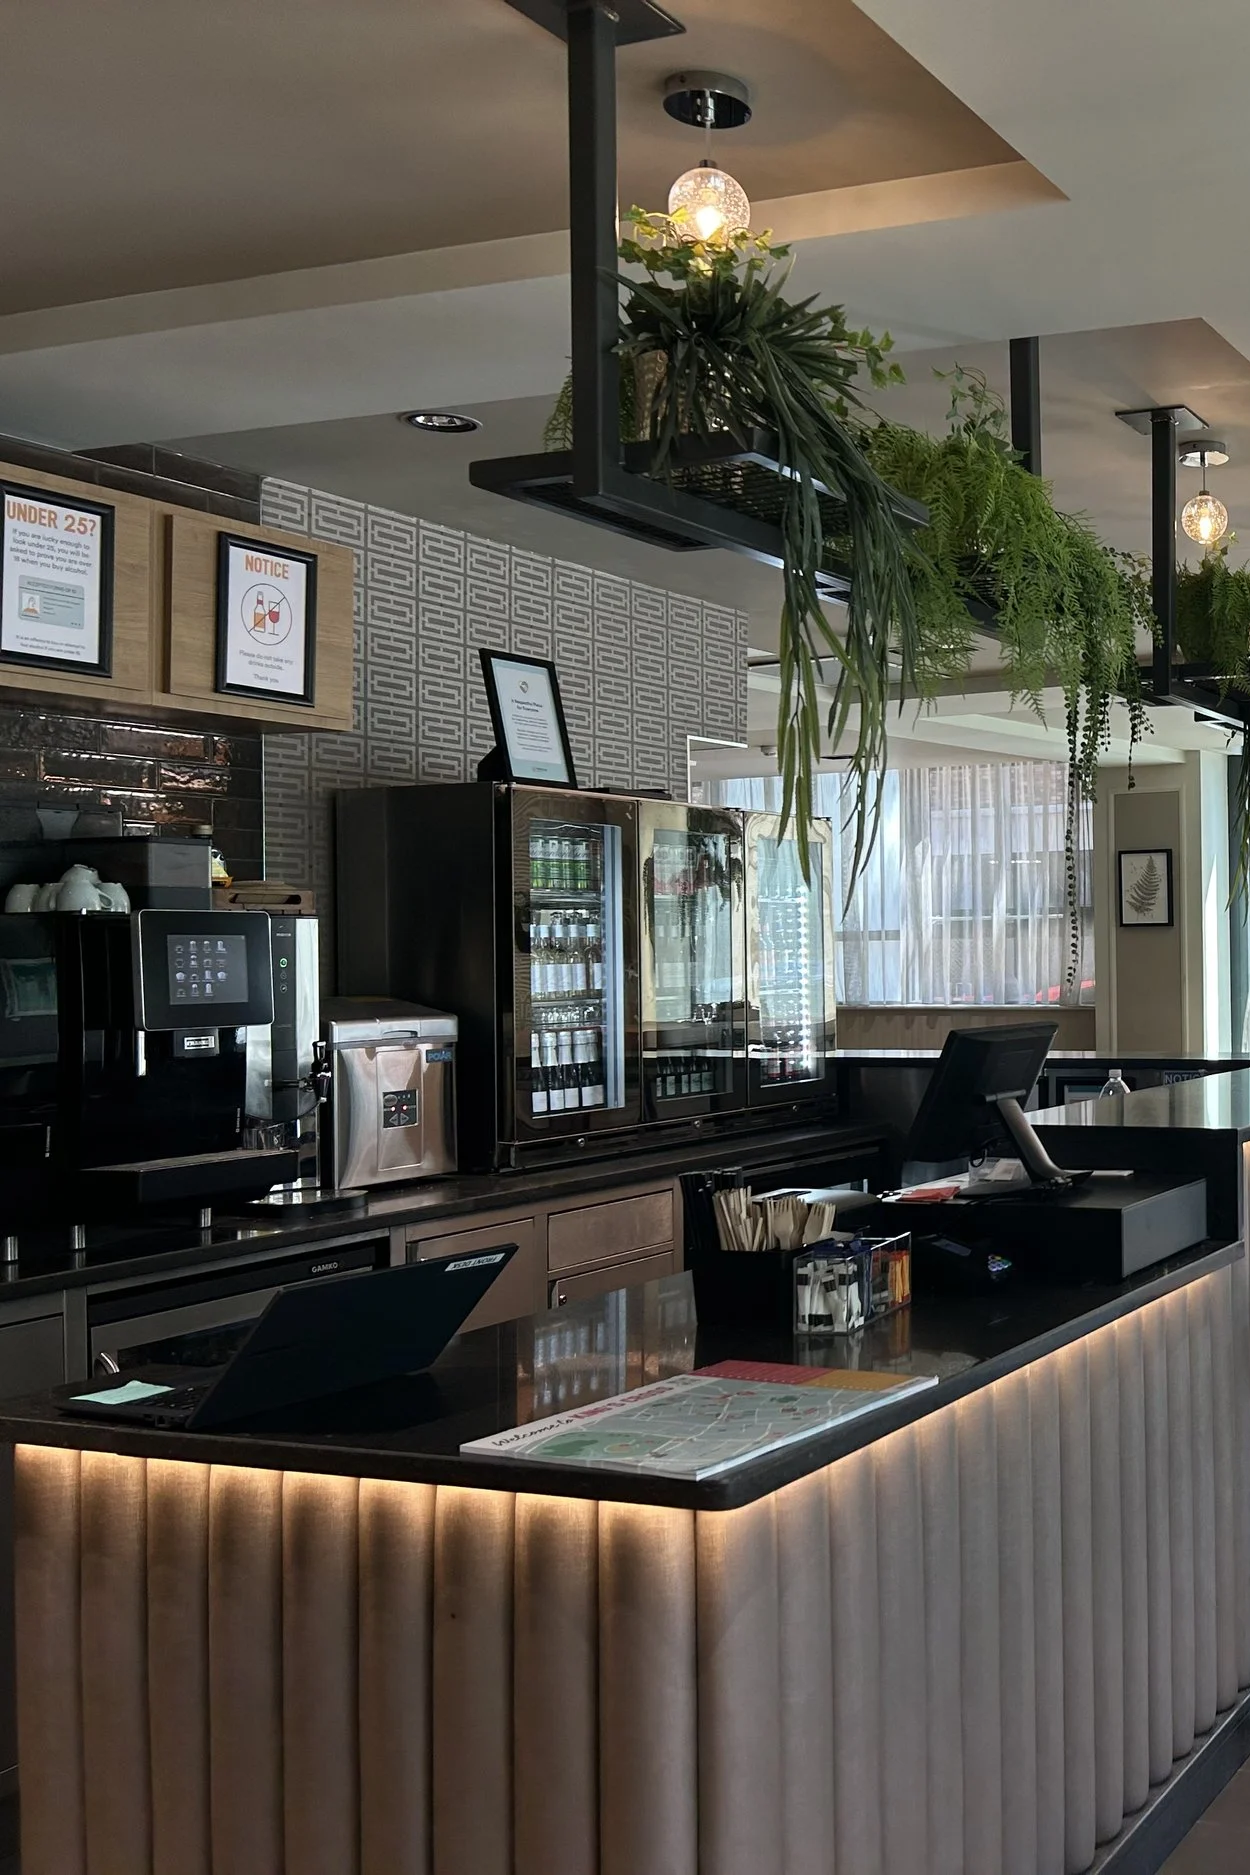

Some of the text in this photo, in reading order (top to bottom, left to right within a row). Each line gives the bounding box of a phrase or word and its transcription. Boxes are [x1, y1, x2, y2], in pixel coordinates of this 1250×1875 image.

[6, 500, 96, 537] UNDER 25?
[12, 537, 26, 545] look
[42, 535, 59, 544] lucky
[60, 540, 82, 549] enough
[10, 546, 28, 555] asked
[37, 552, 54, 560] prove
[79, 560, 92, 568] over
[21, 558, 38, 566] when
[52, 563, 64, 572] buy
[245, 554, 289, 579] NOTICE
[239, 649, 256, 659] Please
[311, 1261, 339, 1273] GAMKO
[491, 1423, 560, 1447] Welcome
